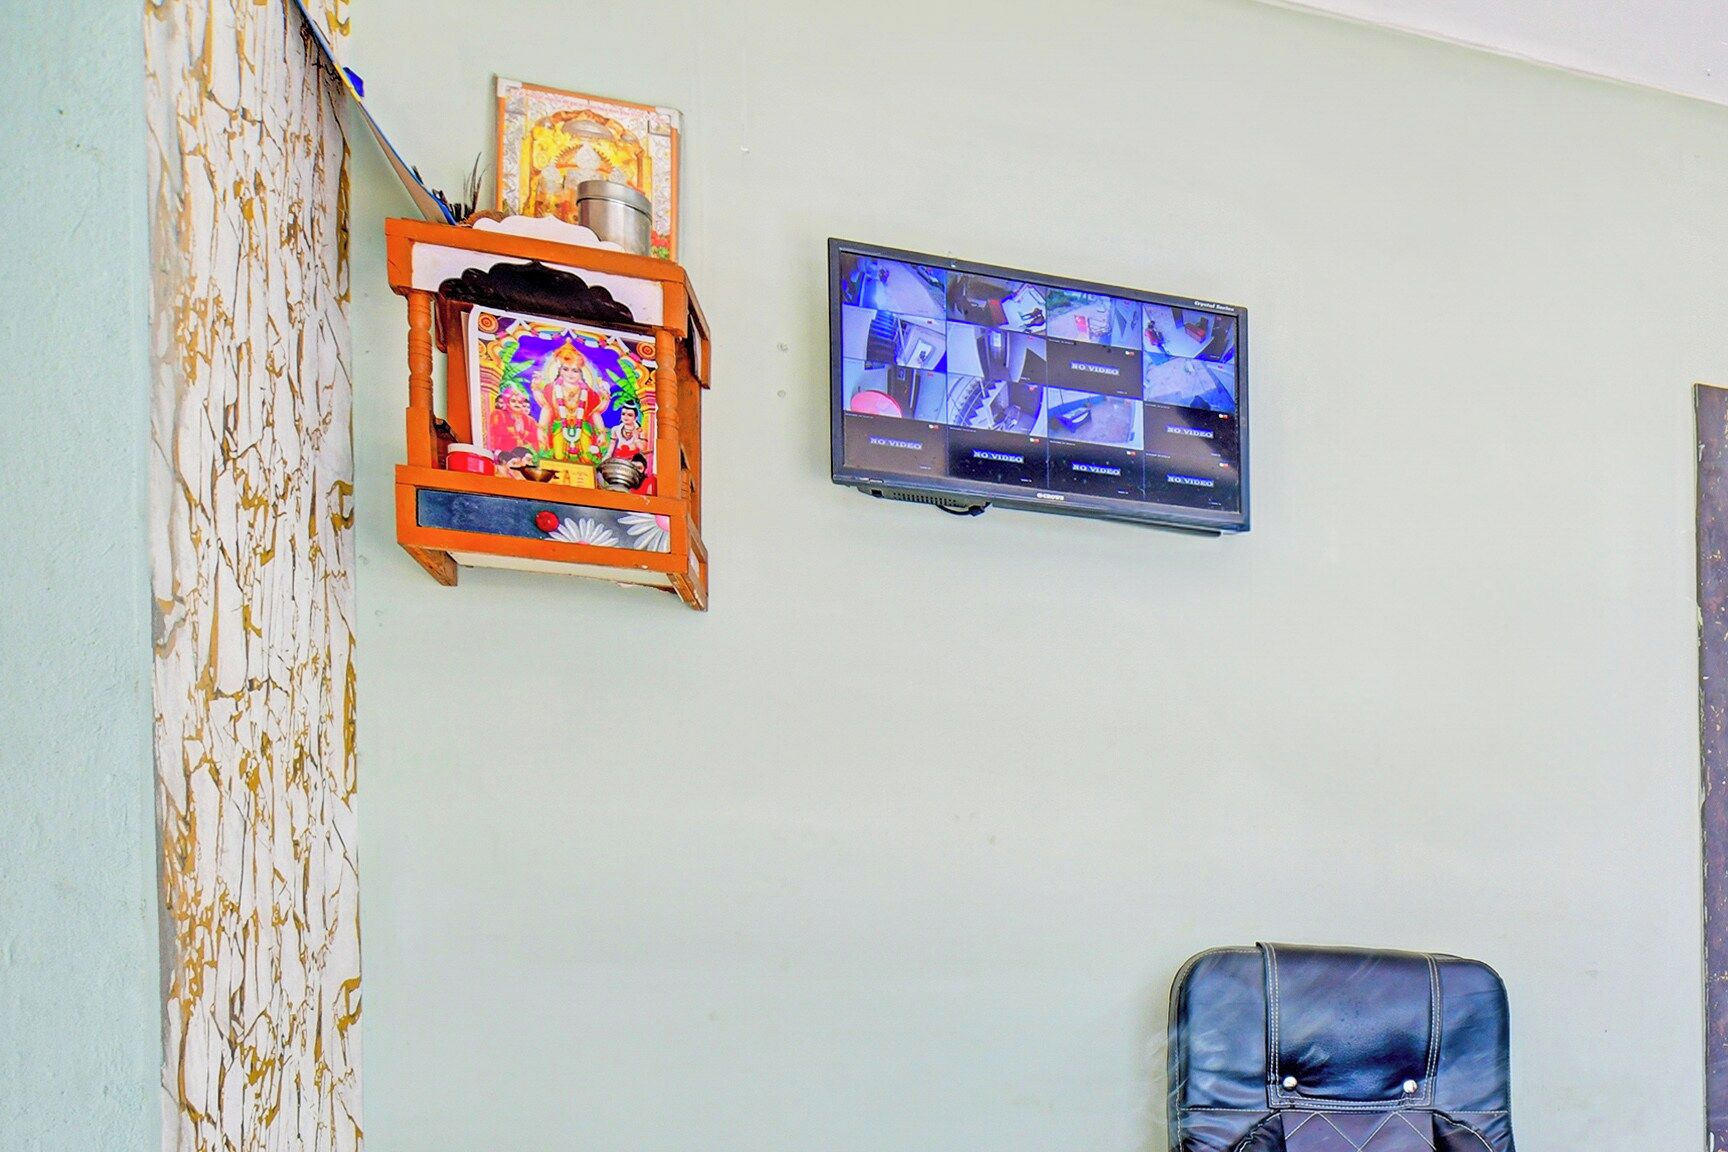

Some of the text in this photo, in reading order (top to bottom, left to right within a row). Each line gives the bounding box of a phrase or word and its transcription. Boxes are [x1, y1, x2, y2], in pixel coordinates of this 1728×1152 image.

[1071, 362, 1120, 375] NO VIDEO
[1167, 426, 1214, 438] NO VIDEO
[870, 437, 922, 450] NO VIDEO
[973, 451, 1024, 463] NO VIDEO
[1073, 463, 1121, 476] NO VIDEO
[1167, 475, 1214, 487] NO VIDEO
